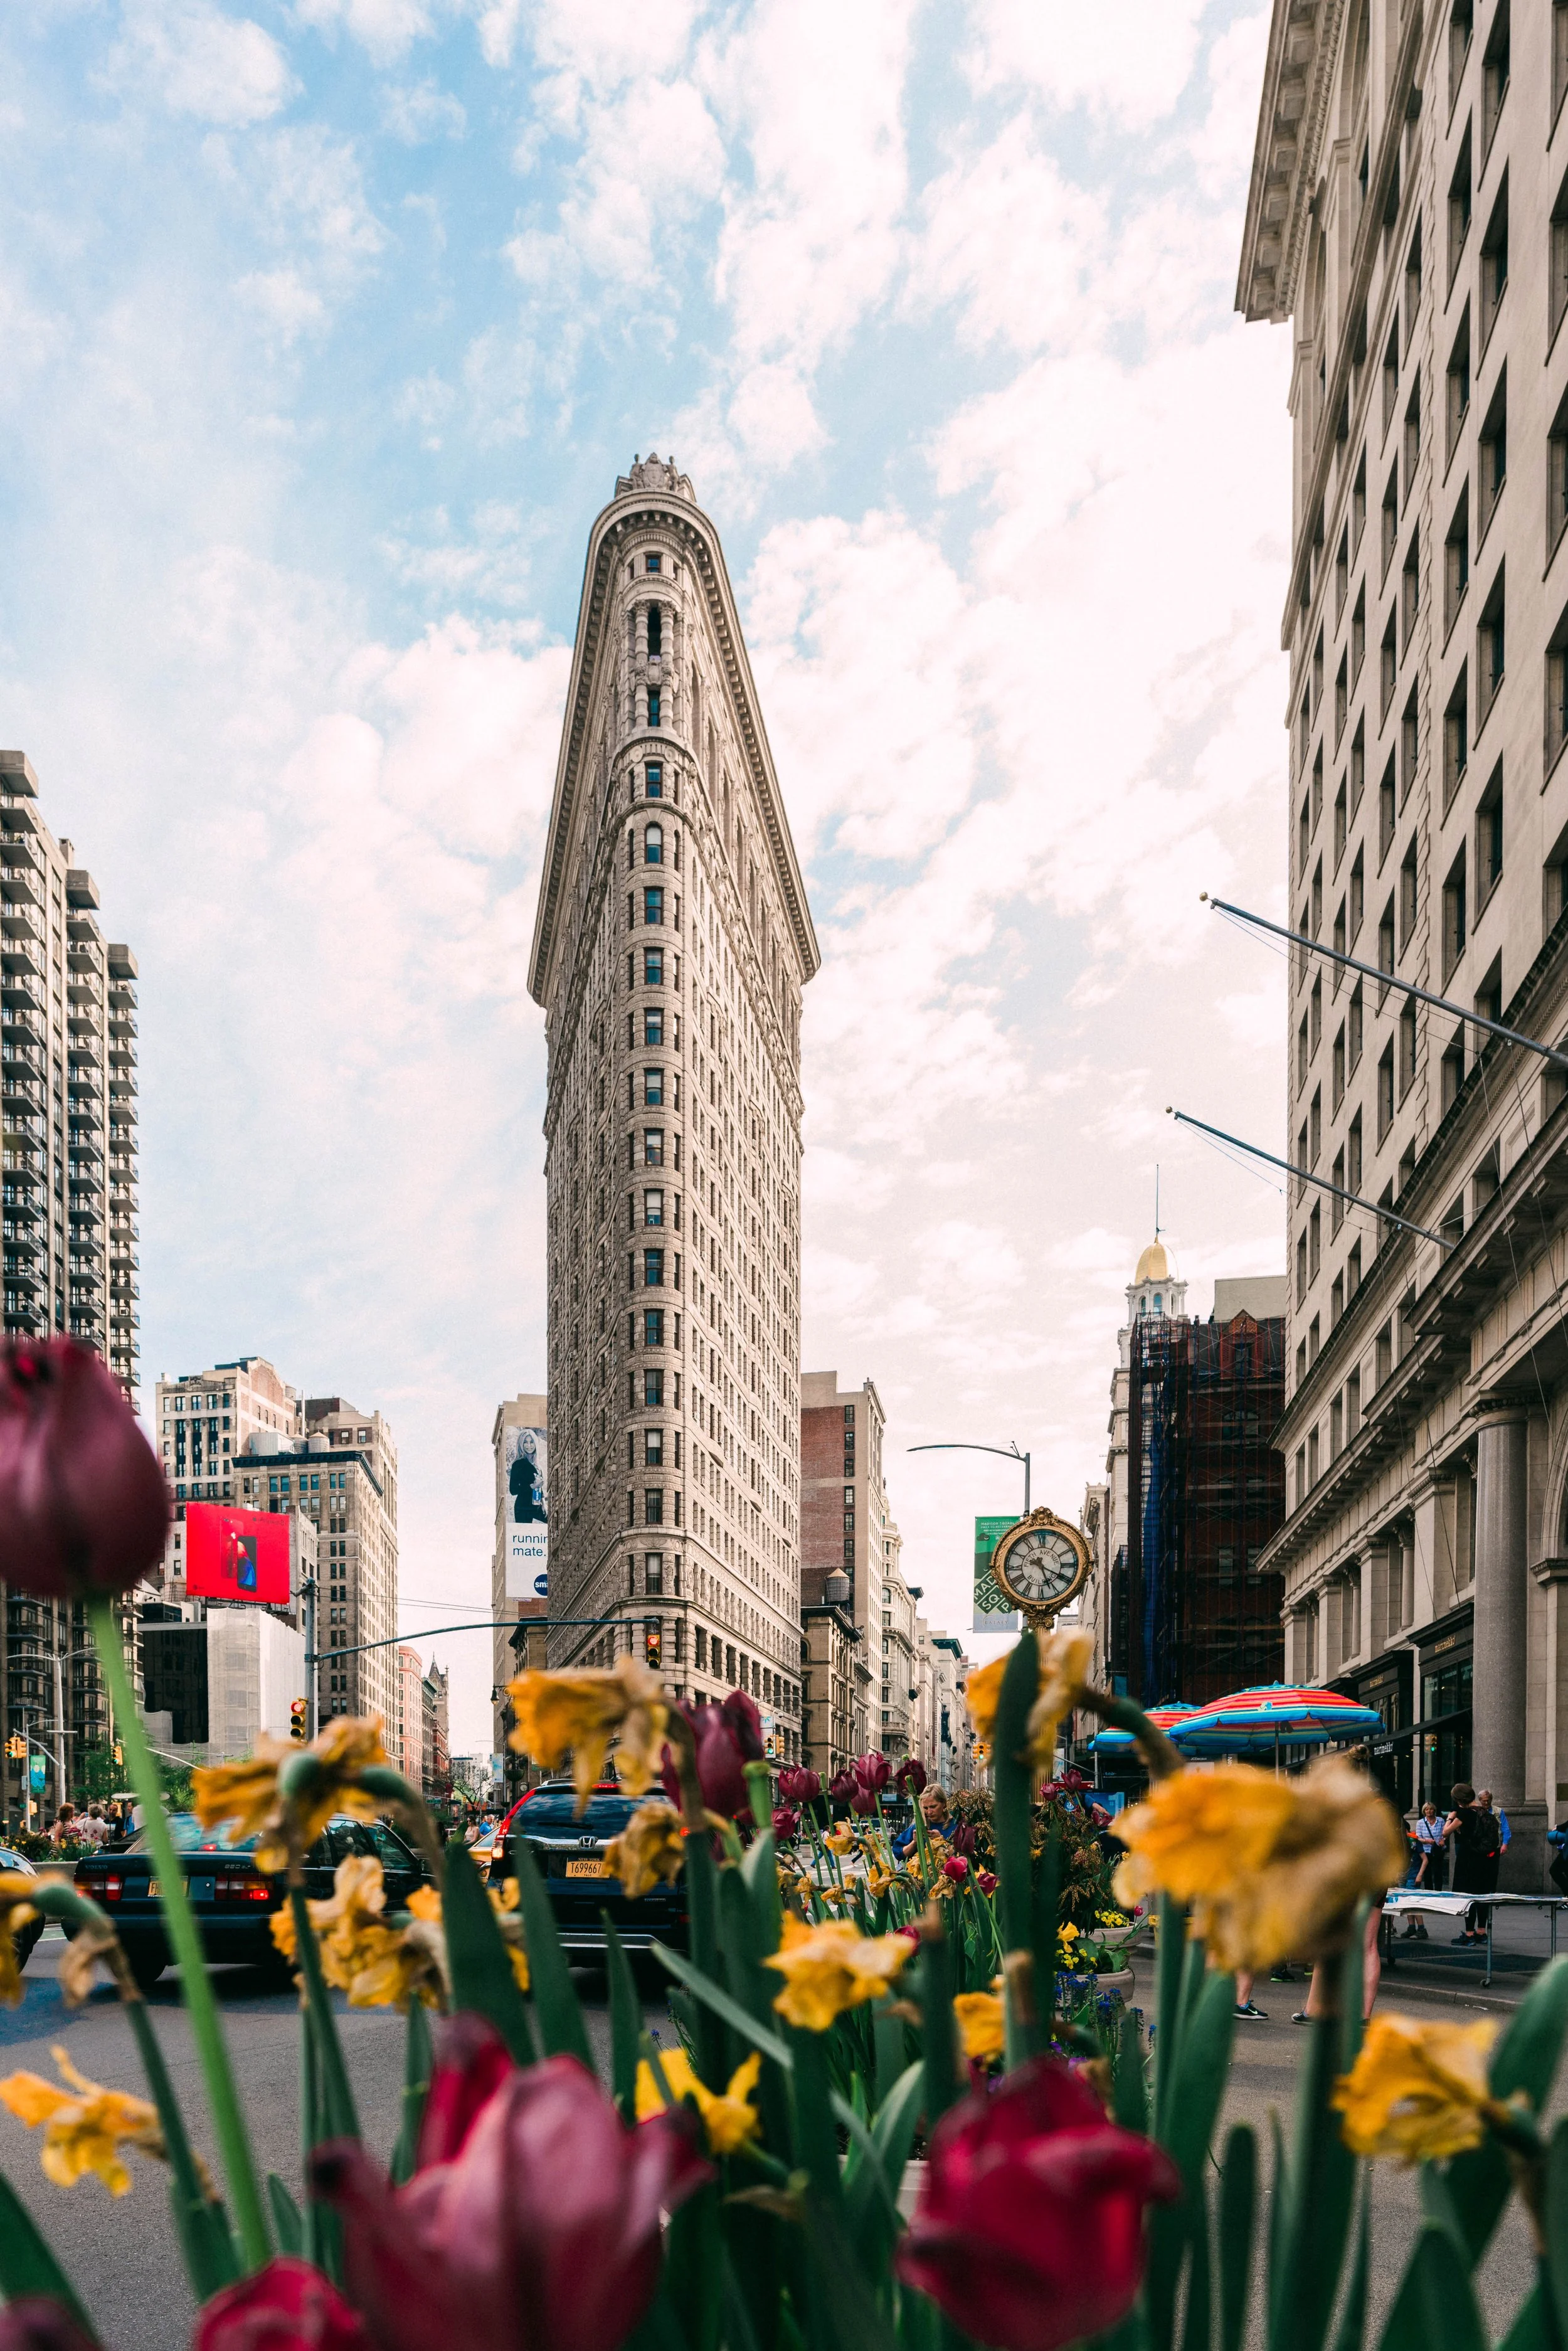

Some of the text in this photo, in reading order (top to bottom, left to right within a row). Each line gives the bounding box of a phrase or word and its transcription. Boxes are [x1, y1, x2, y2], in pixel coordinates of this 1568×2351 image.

[513, 1547, 546, 1556] mate.
[1024, 1549, 1059, 1568] FIFTH AVENUE
[982, 1594, 1003, 1610] SQ.
[1374, 1742, 1393, 1755] marimekko
[571, 1862, 601, 1874] T699667
